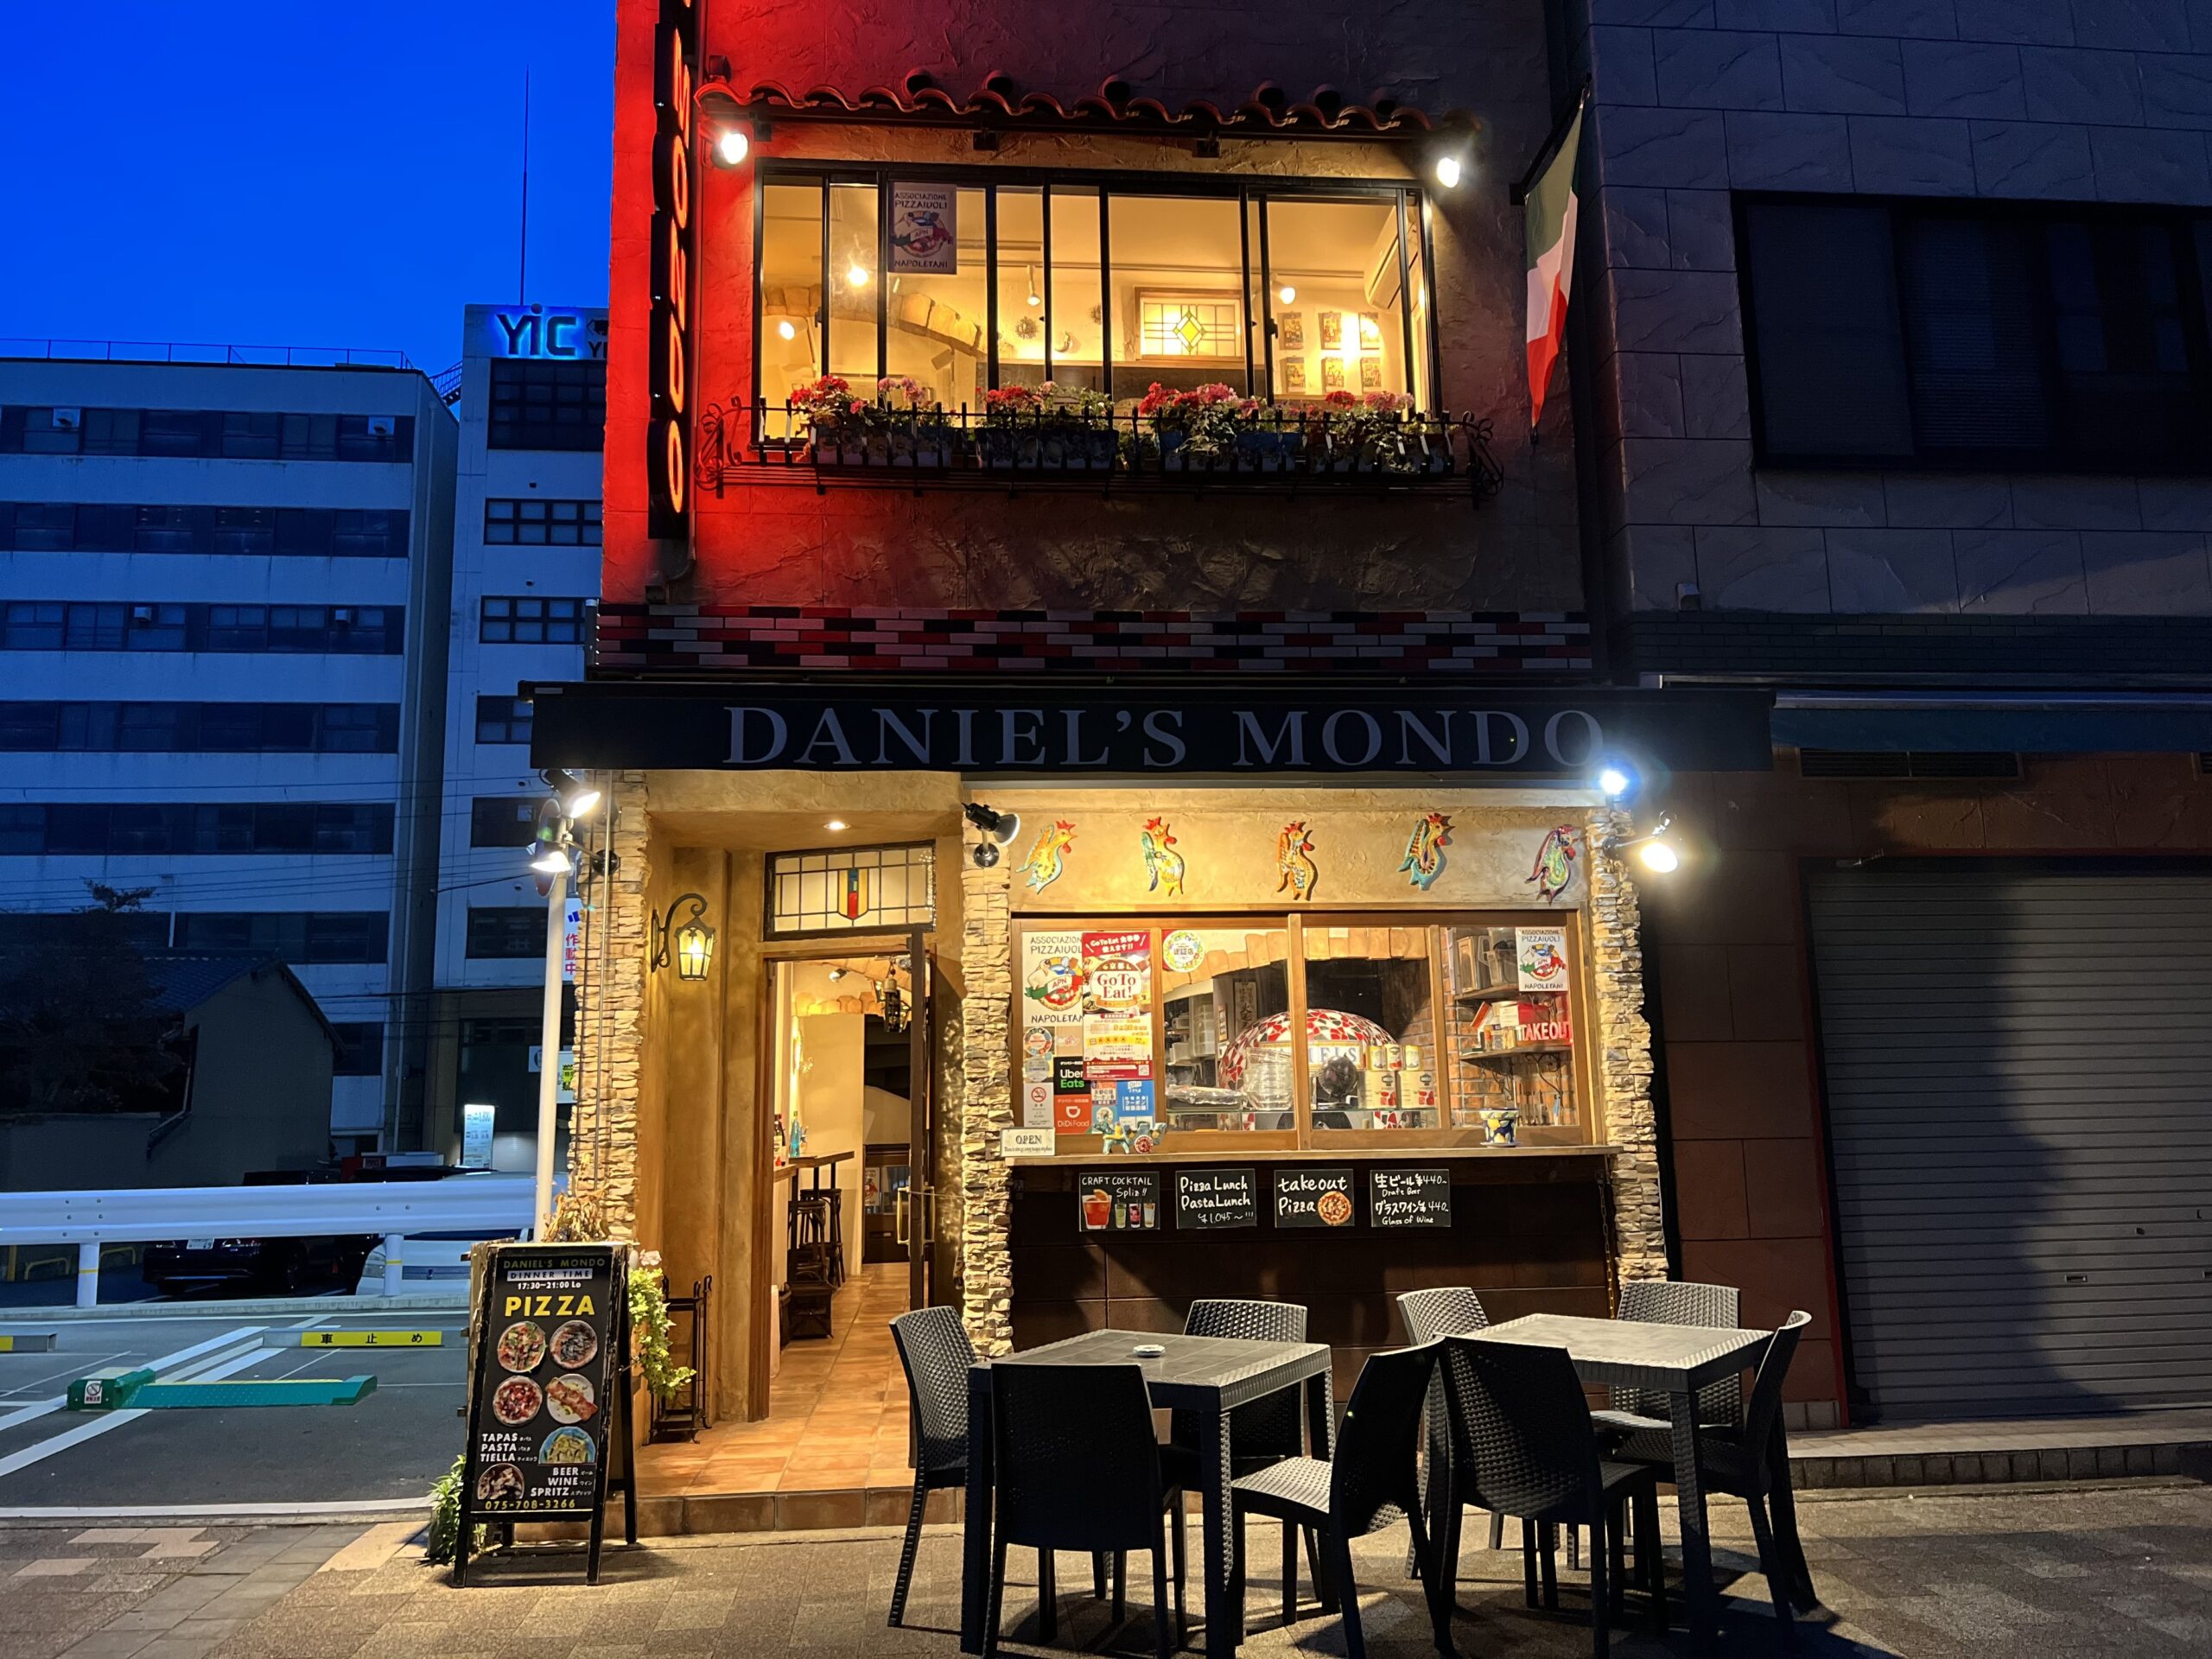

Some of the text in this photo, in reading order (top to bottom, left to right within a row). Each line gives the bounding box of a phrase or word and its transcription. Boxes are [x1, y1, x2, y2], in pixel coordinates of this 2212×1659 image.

[894, 200, 947, 209] PIZZAIUOLI
[894, 259, 948, 268] NAPOLETANI
[722, 706, 1604, 767] DANIEL'S MONDO
[1031, 945, 1082, 954] PIZZAIUOL
[1052, 977, 1067, 988] APN
[1103, 986, 1132, 998] Eat!
[1031, 1014, 1083, 1024] NAPOLETAN
[1060, 1069, 1084, 1078] Uber
[1060, 1079, 1084, 1088] Eats
[1015, 1135, 1042, 1145] OPEN
[1082, 1176, 1153, 1185] CRAFT COCKTAIL
[1180, 1175, 1248, 1193] Pizza Lunch
[1382, 1188, 1405, 1197] Draft
[1181, 1192, 1251, 1211] Pasta Lunch
[1278, 1196, 1316, 1217] Pizza
[1382, 1217, 1402, 1225] Glass
[1404, 1216, 1414, 1224] of
[560, 1257, 606, 1268] MONDO
[505, 1295, 594, 1317] PIZZA
[321, 1332, 423, 1344] 車止め
[482, 1433, 518, 1442] TAPAS
[481, 1443, 517, 1452] PASTA
[480, 1453, 516, 1462] TIELLA
[553, 1467, 578, 1476] BEER
[548, 1477, 578, 1486] WINE
[531, 1487, 569, 1497] SPRITZ
[485, 1499, 575, 1510] 075-708-3266
